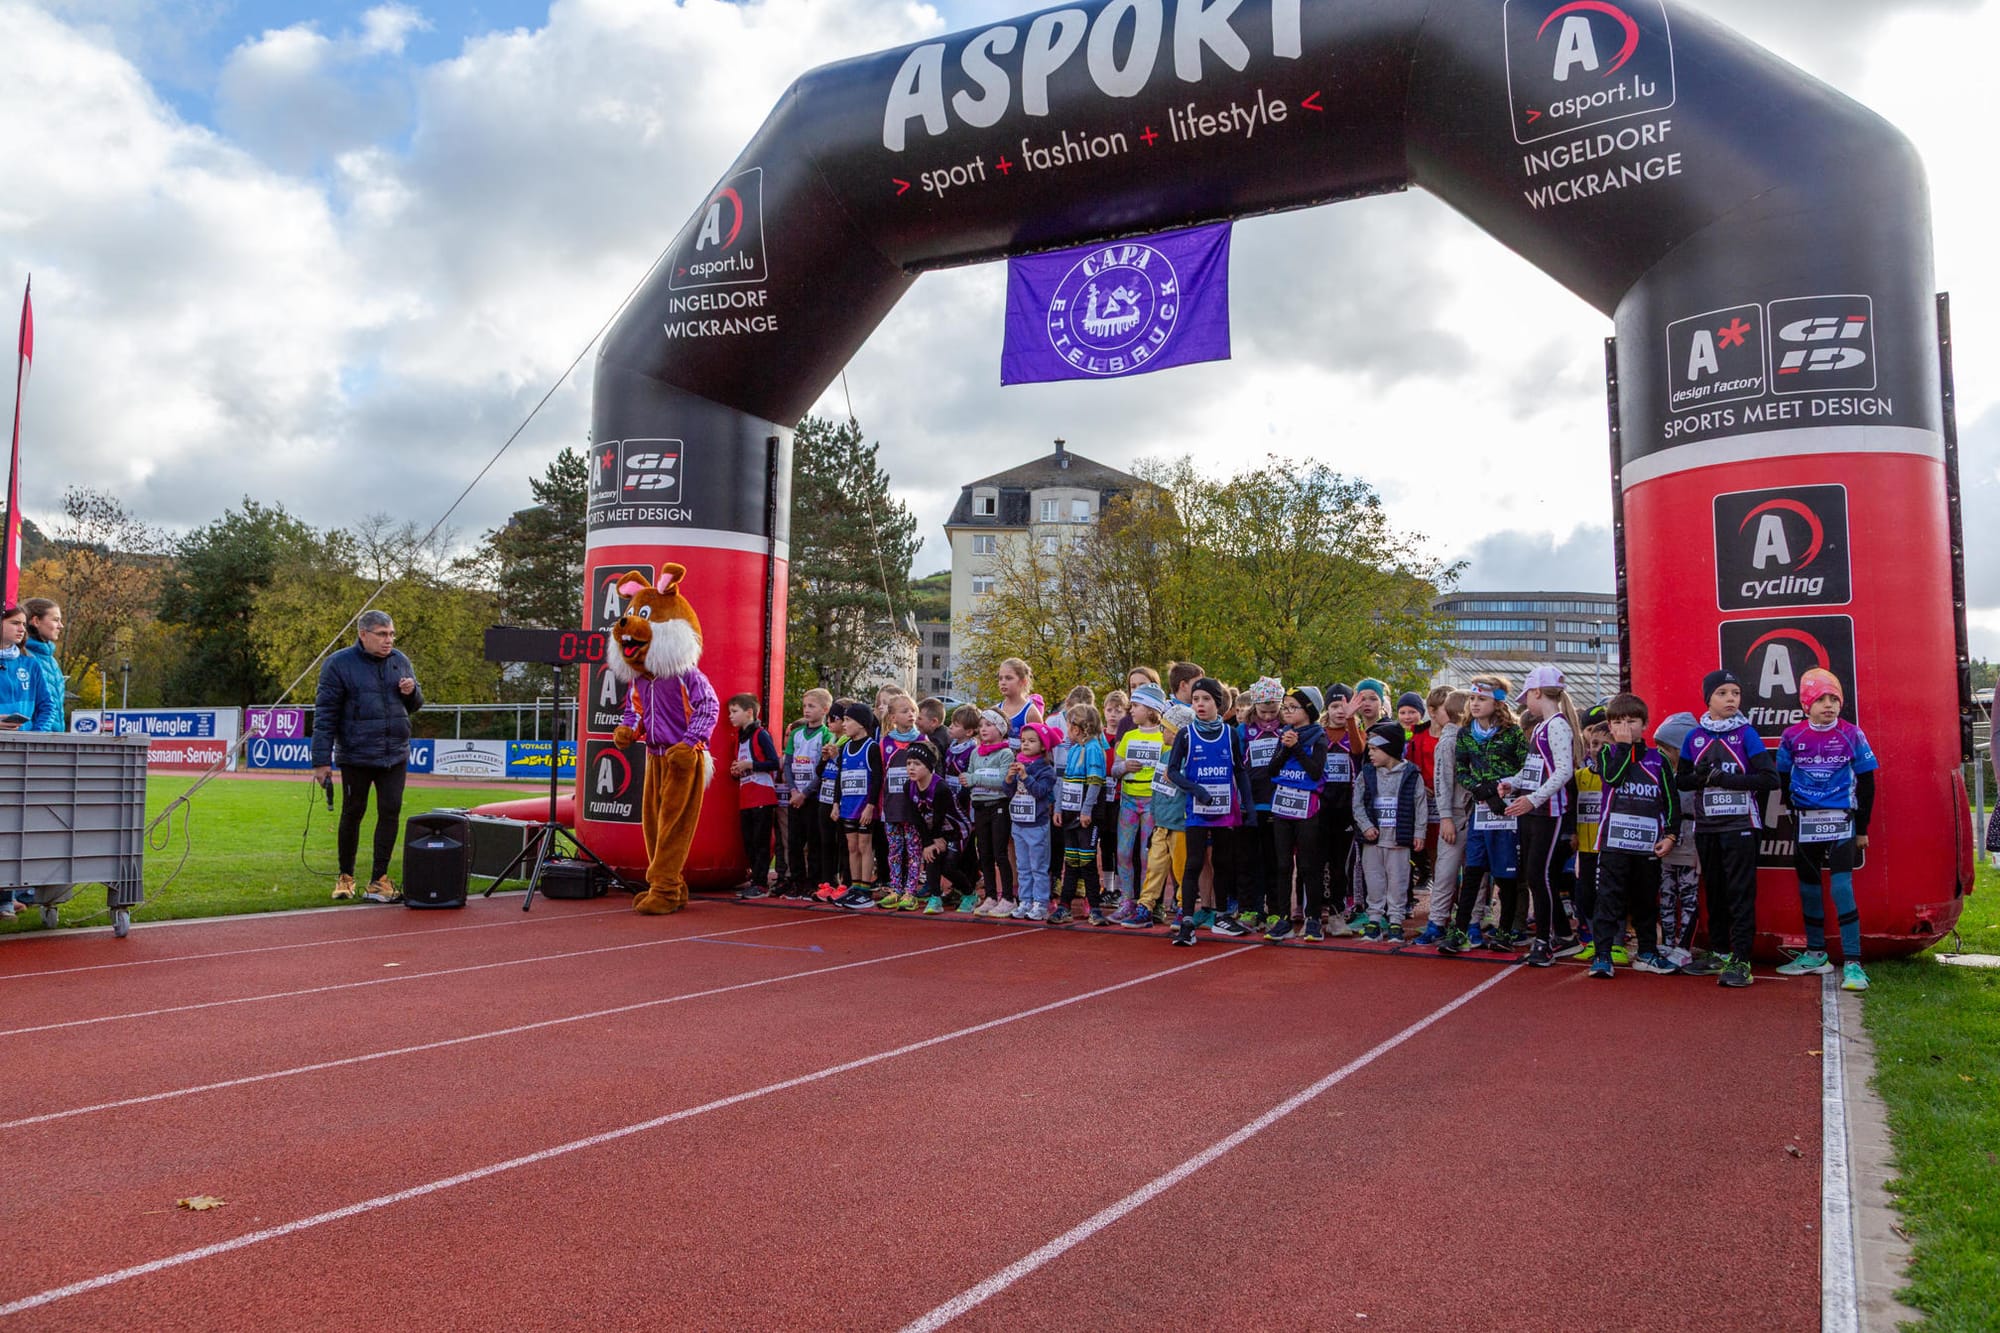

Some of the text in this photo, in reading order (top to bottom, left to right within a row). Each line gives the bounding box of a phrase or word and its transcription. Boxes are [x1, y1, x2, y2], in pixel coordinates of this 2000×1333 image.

[1549, 75, 1656, 118] asport.lu
[920, 155, 986, 198] sport
[1021, 129, 1128, 171] fashion
[1168, 89, 1288, 142] lifestyle
[1523, 120, 1672, 176] INGELDORF
[1523, 153, 1682, 210] WICKRANGE
[689, 250, 754, 279] asport.lu
[1082, 246, 1151, 279] CAPA
[669, 290, 768, 313] INGELDORF
[664, 315, 778, 339] WICKRANGE
[1051, 277, 1176, 373] ETTELBRUCK
[1672, 376, 1762, 402] design factory
[1664, 398, 1893, 439] SPORTS MEET DESIGN
[607, 508, 635, 521] MEET
[638, 508, 692, 521] DESIGN
[1740, 576, 1824, 599] cycling
[78, 720, 94, 731] Ford
[119, 716, 143, 733] Paul
[146, 716, 193, 736] Wengler
[277, 714, 293, 730] BIL
[594, 711, 625, 725] fitnes
[1748, 707, 1804, 725] fitne
[1197, 766, 1228, 777] ASPORT
[589, 800, 632, 817] running
[1712, 794, 1732, 804] 868
[1380, 809, 1396, 817] 719
[1623, 829, 1642, 840] 864
[1815, 824, 1836, 833] 899
